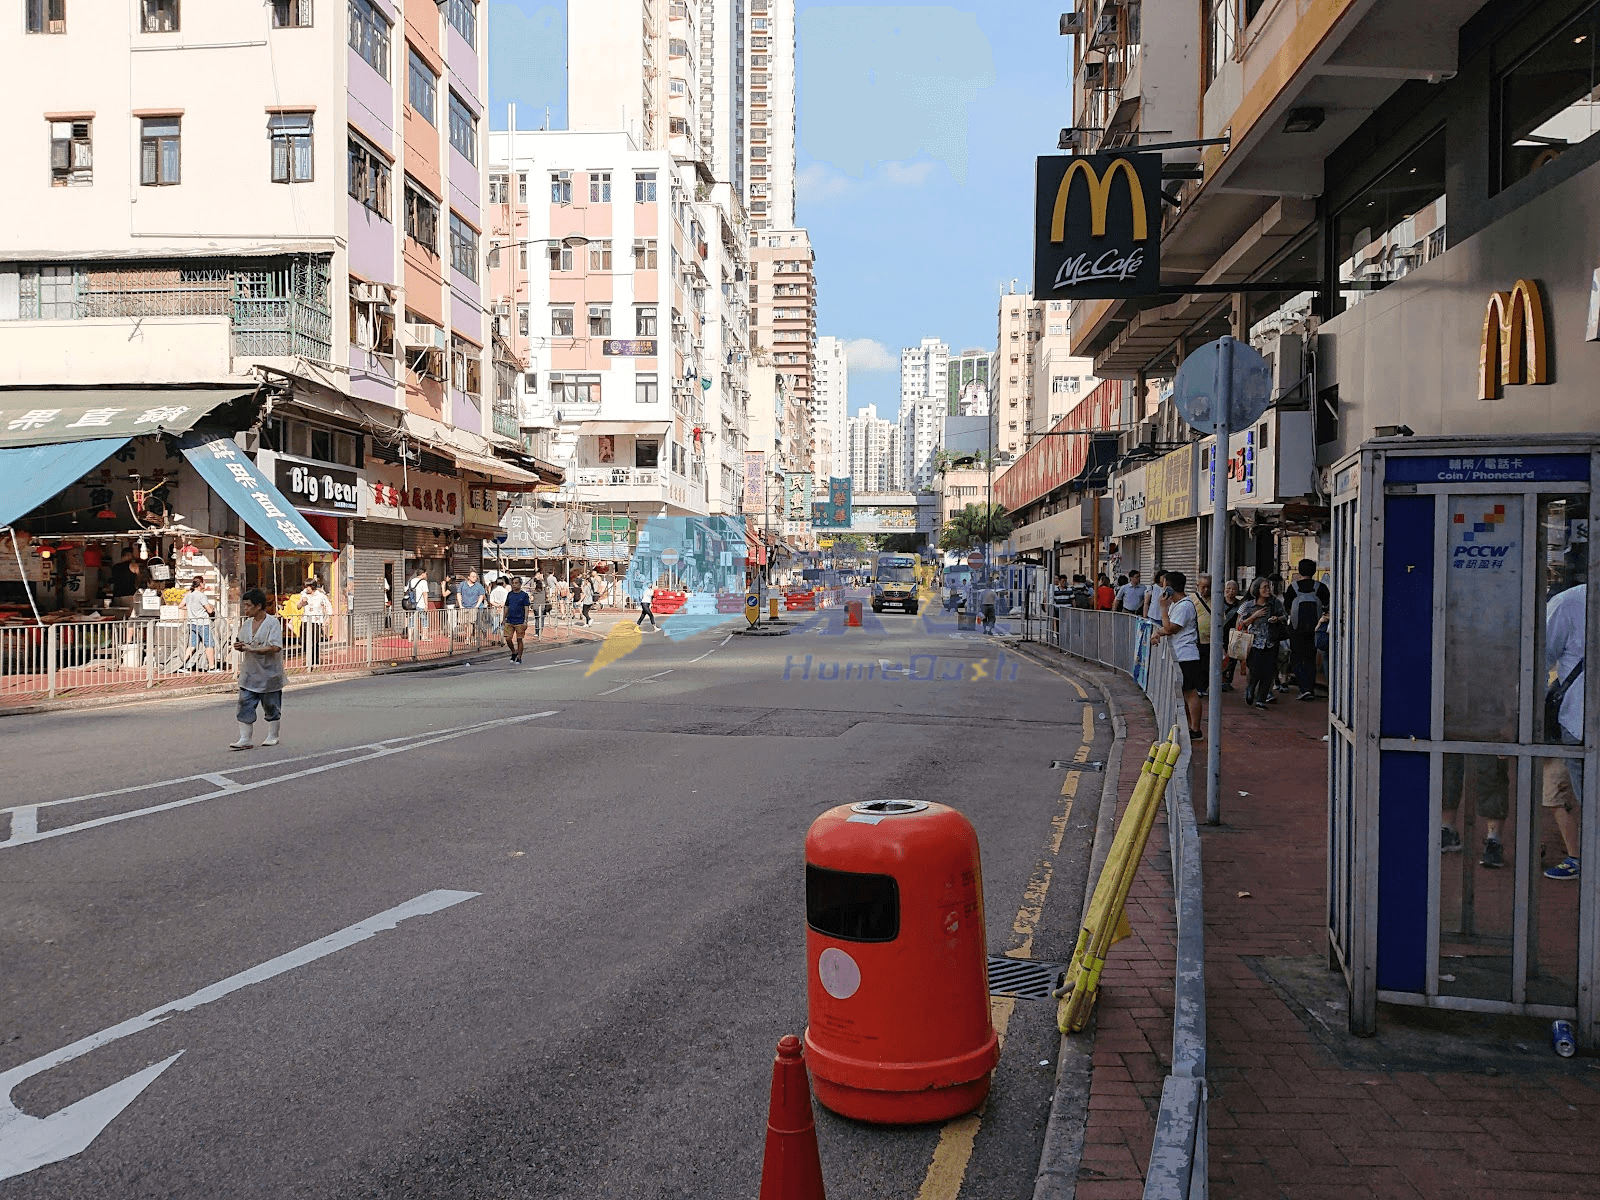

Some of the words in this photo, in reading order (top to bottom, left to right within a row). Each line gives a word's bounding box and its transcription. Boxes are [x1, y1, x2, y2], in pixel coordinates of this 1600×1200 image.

[1053, 247, 1144, 287] McCafé
[0, 406, 191, 431] 果直銷
[291, 466, 319, 502] Big
[323, 475, 357, 502] Bear
[512, 531, 553, 542] HONORE
[1453, 545, 1510, 557] PCCW
